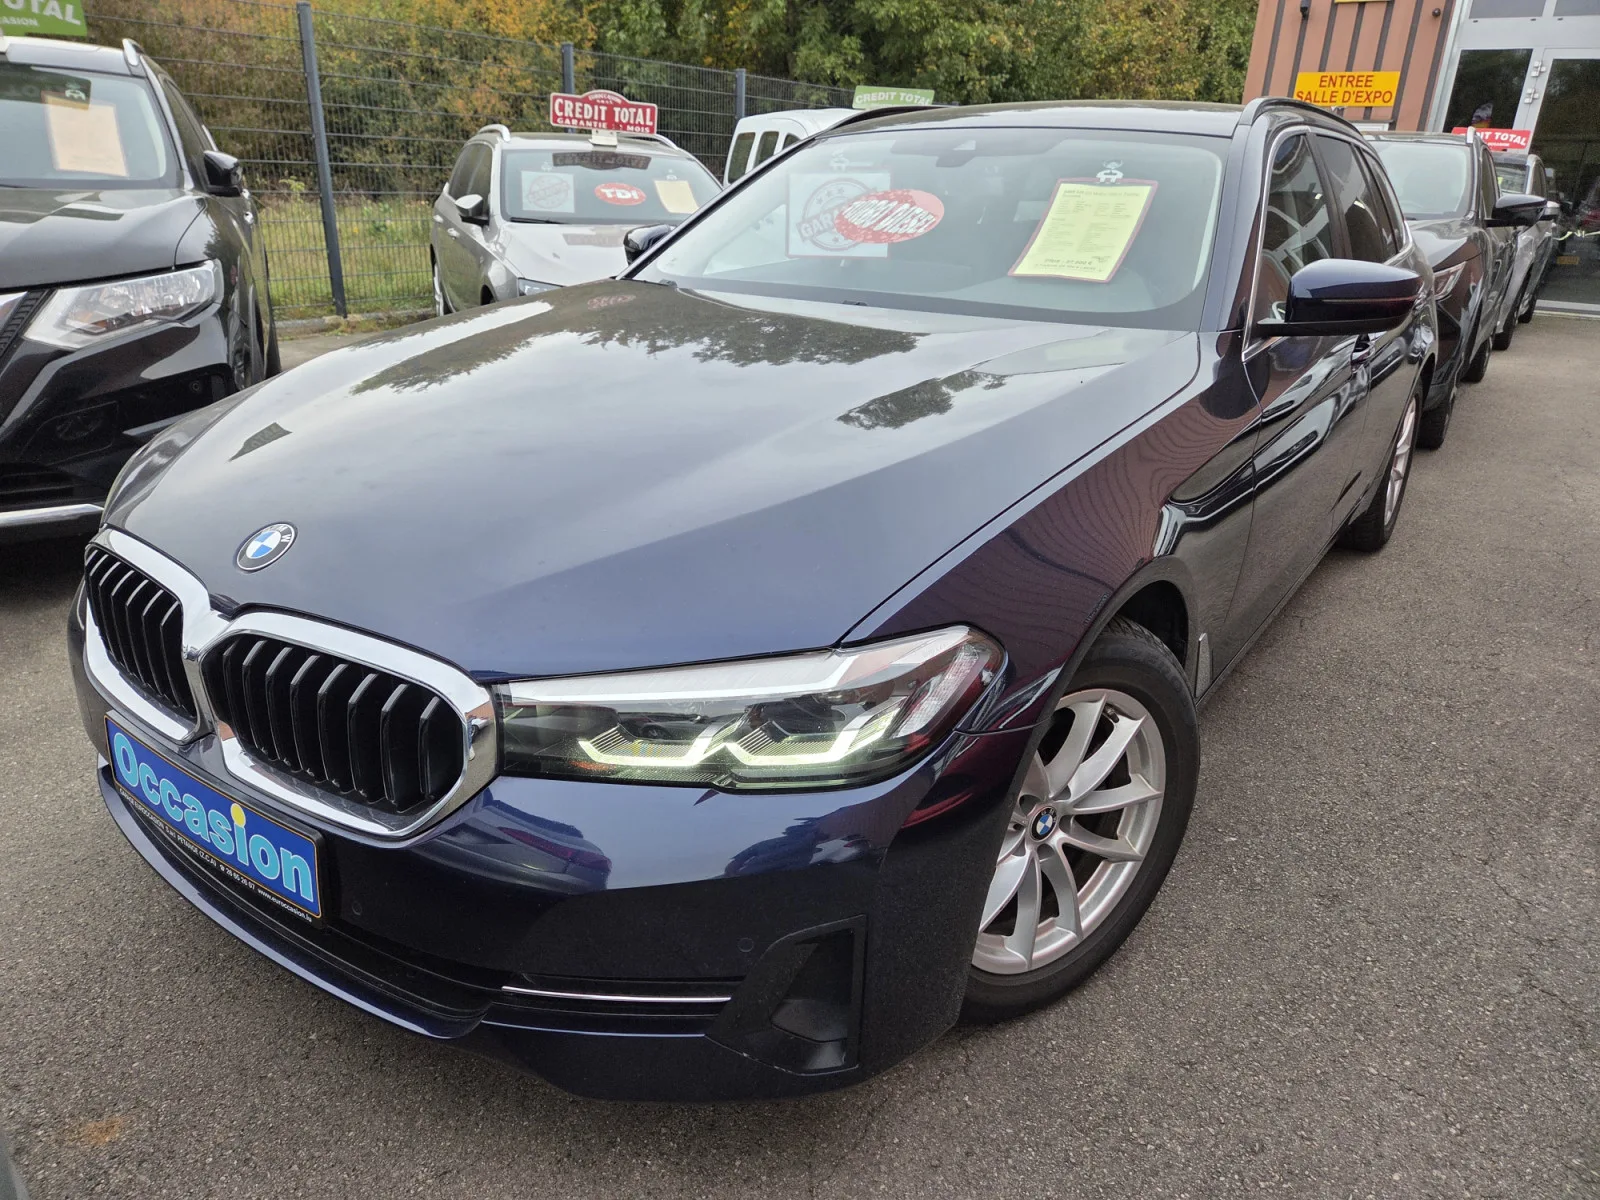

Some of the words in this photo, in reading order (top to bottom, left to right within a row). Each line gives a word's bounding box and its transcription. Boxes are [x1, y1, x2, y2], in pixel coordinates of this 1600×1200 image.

[1319, 75, 1374, 88] ENTREE
[855, 92, 897, 104] CREDIT
[900, 92, 931, 106] TOTAL
[1296, 91, 1338, 103] SALLE
[1342, 91, 1393, 103] D'EXPO
[554, 98, 607, 121] CREDIT
[613, 107, 653, 126] TOTAL
[557, 117, 608, 129] GARANTIE
[626, 125, 650, 133] MOIS
[1495, 132, 1527, 146] TOTAL
[601, 188, 639, 200] TDI
[114, 732, 314, 902] Occasion
